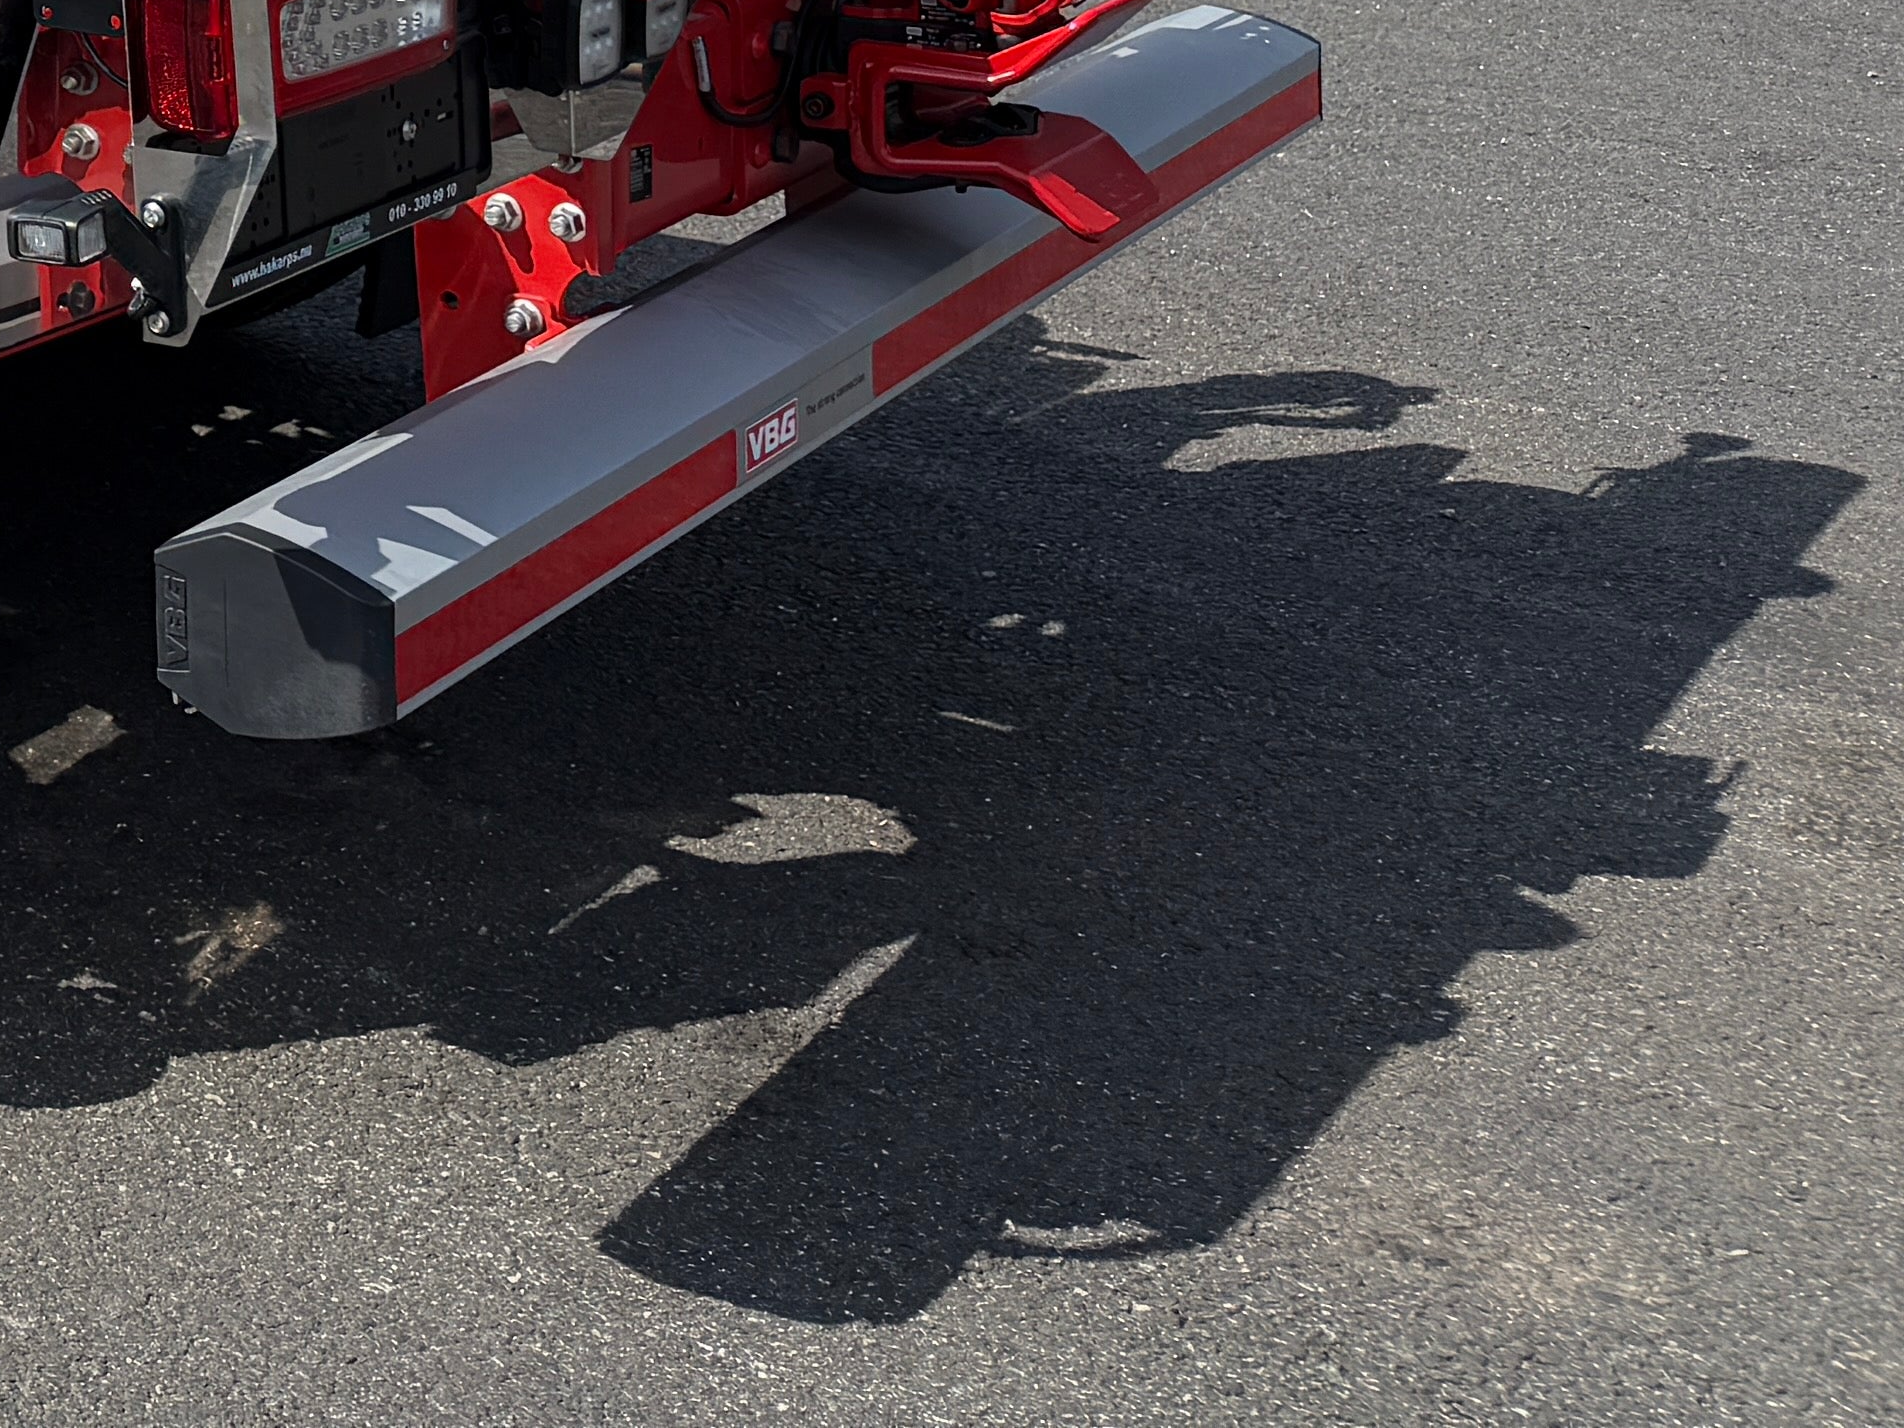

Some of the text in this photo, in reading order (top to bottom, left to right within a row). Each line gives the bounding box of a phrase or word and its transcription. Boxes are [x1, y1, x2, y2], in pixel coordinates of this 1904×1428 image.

[388, 203, 406, 223] 010
[413, 193, 431, 212] 330
[432, 187, 444, 205] 99
[446, 182, 457, 199] 10
[748, 406, 796, 461] VBG
